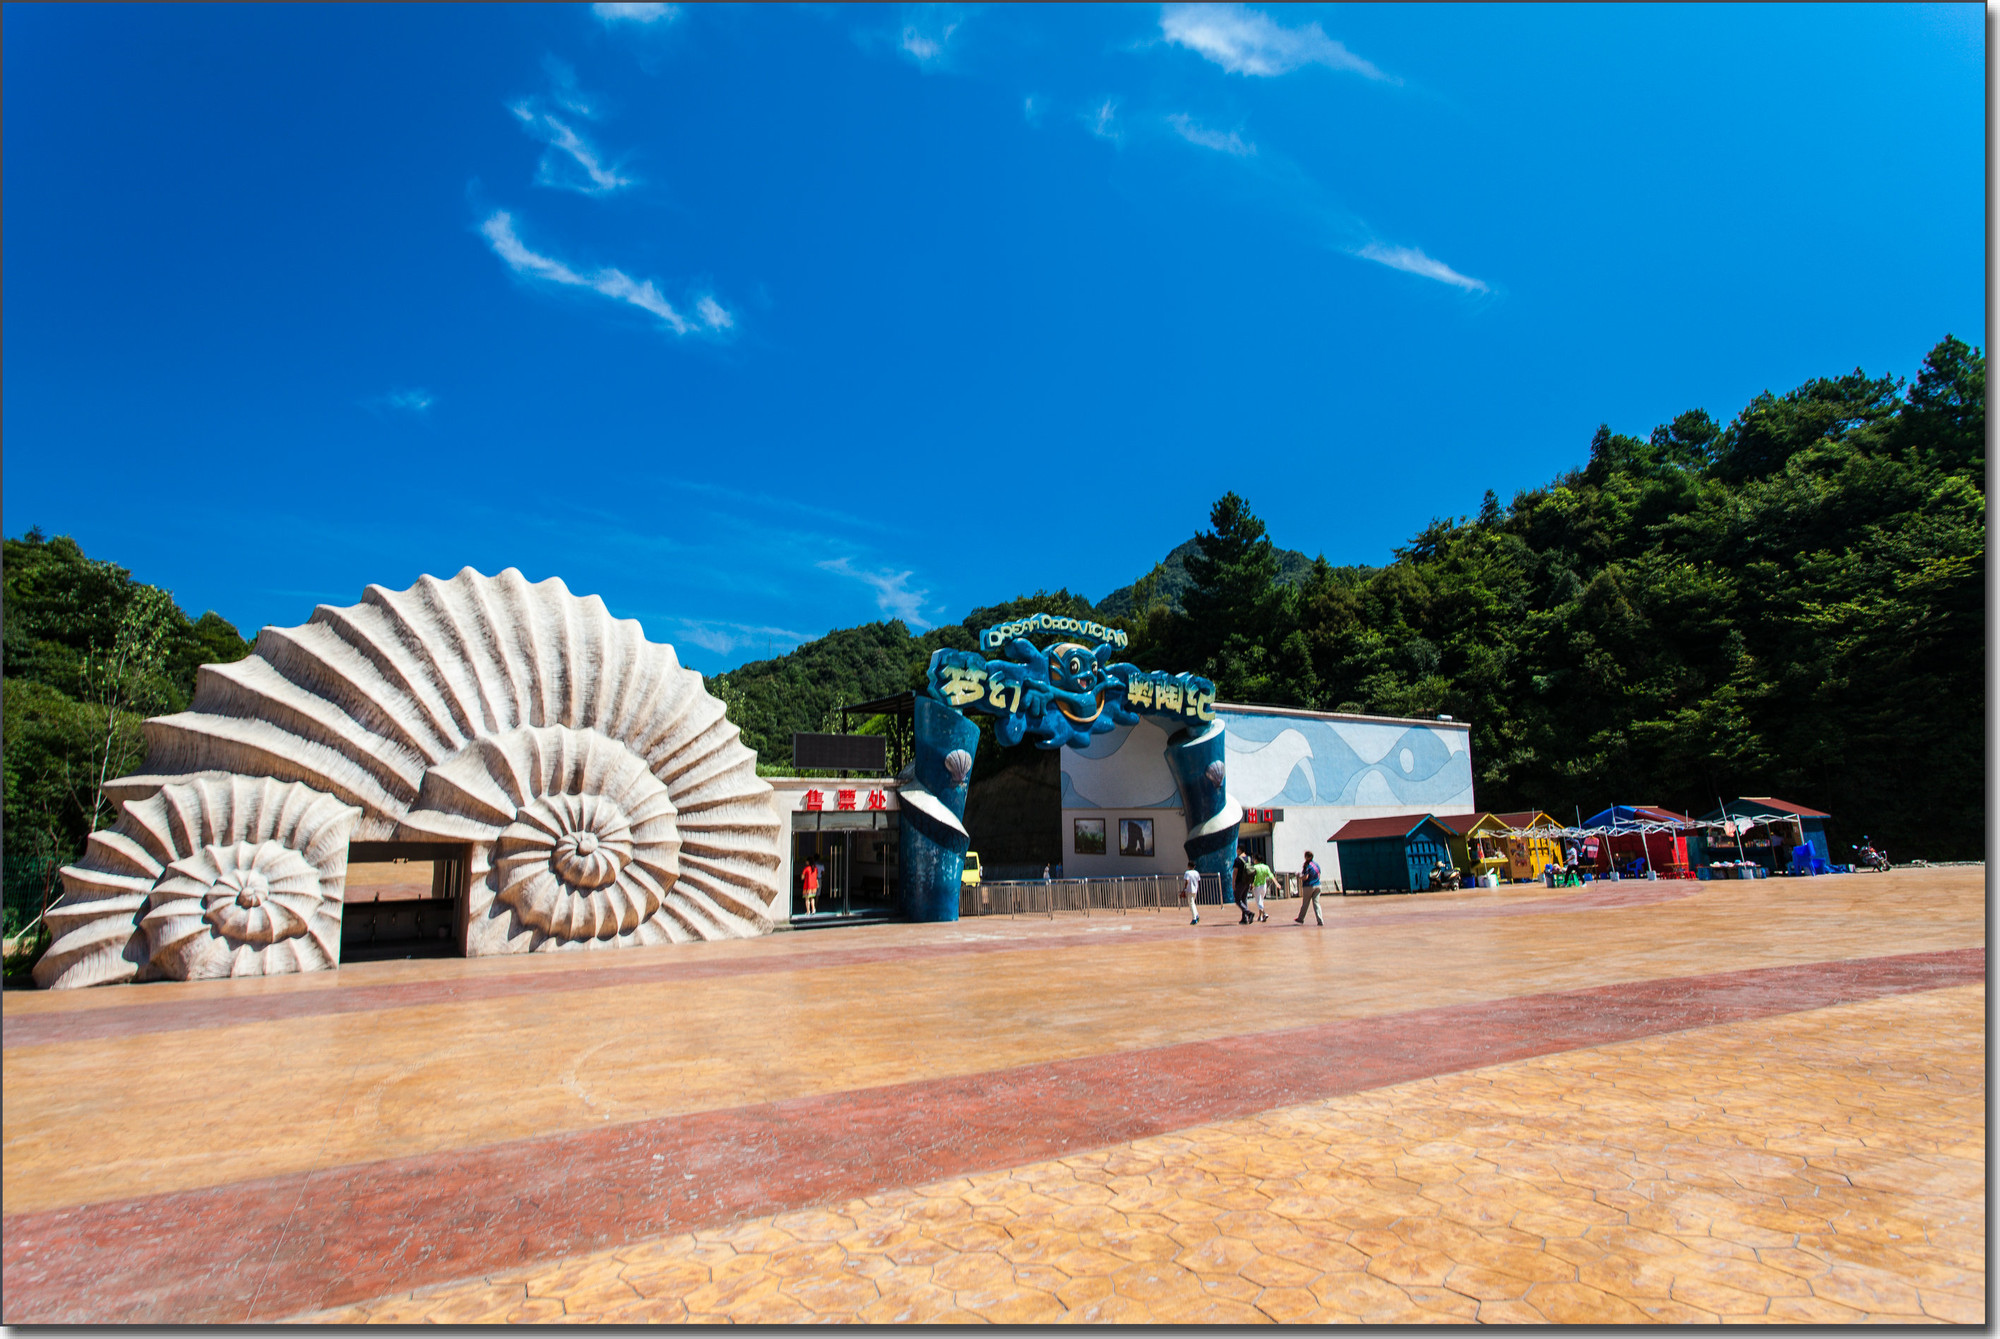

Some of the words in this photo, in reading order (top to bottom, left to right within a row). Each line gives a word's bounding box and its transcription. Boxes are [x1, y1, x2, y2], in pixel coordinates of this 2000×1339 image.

[989, 619, 1040, 647] DREAM
[1041, 614, 1128, 647] ORDOVICIAN
[941, 667, 1021, 713] 梦幻
[1128, 672, 1216, 721] 奥陶纪
[805, 789, 887, 811] 售票处
[1247, 808, 1273, 824] 出口
